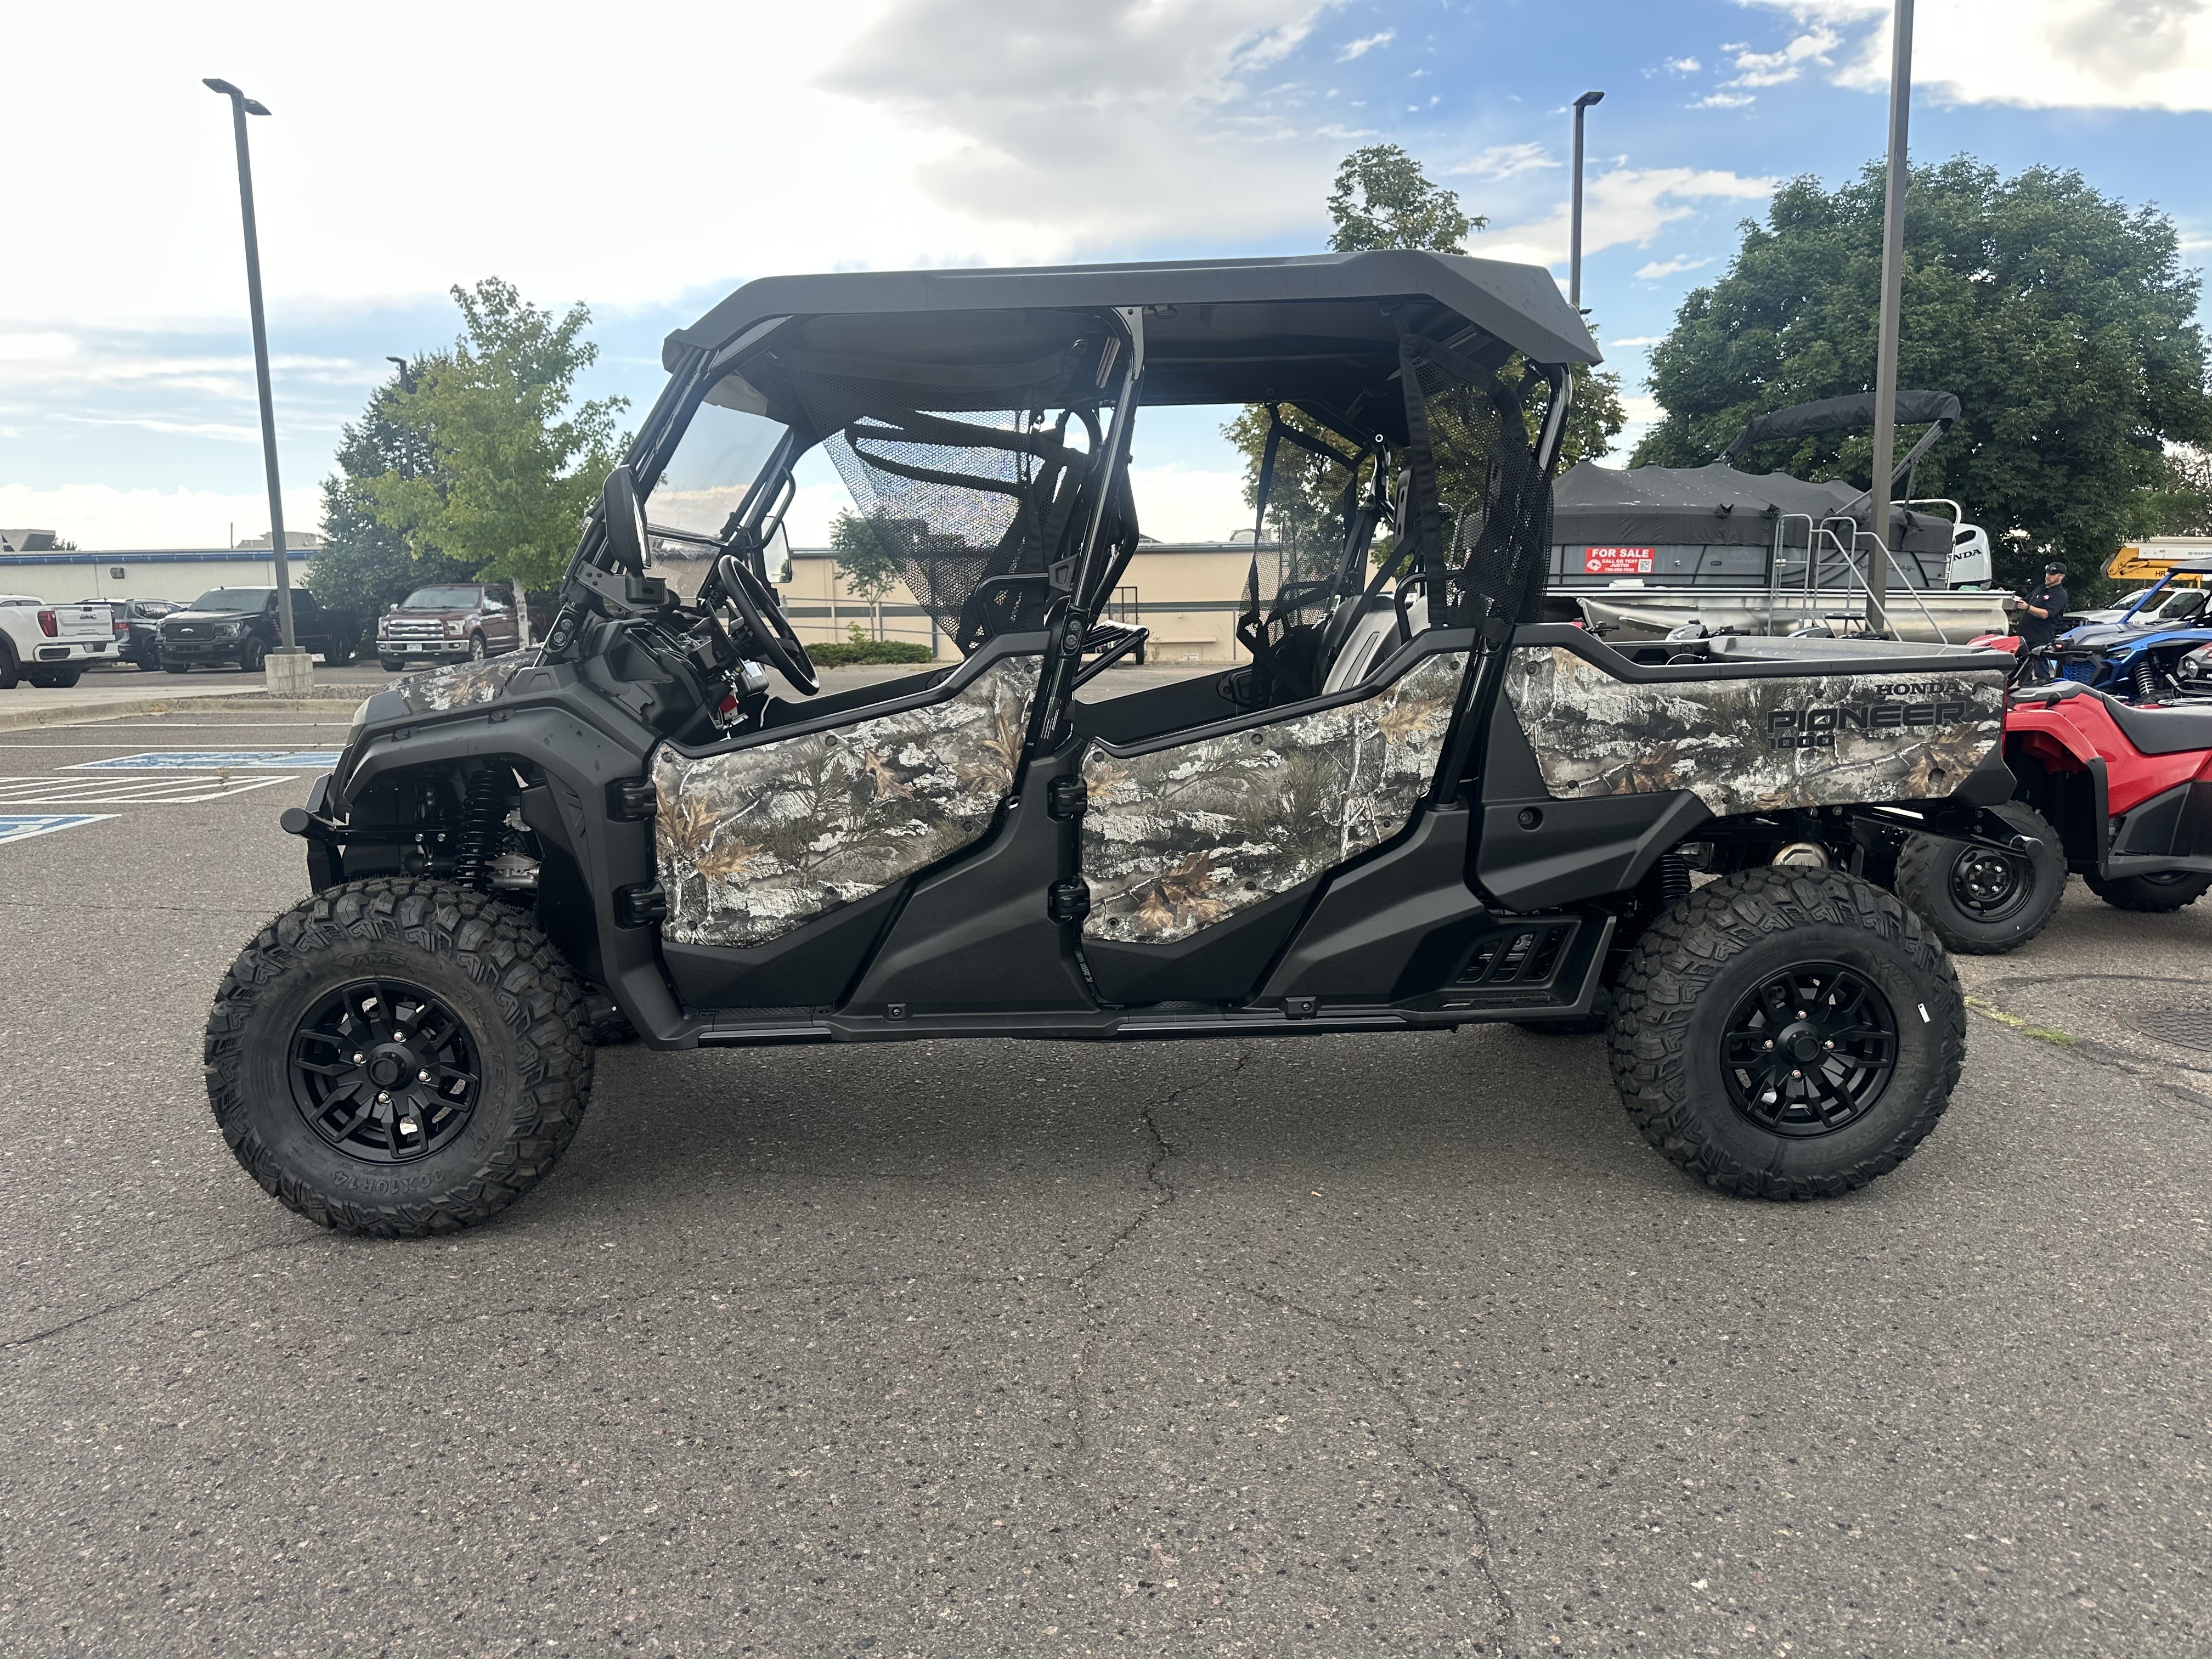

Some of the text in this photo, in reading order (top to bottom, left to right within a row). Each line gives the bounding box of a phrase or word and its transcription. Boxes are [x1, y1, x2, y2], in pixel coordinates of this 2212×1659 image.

[1592, 549, 1649, 557] FOR SALE
[1953, 549, 1982, 561] NDA
[1875, 682, 1961, 695] HONDA
[1768, 702, 1968, 733] PIONEER
[1767, 735, 1836, 749] 1000
[333, 1169, 445, 1194] 30X10R14
